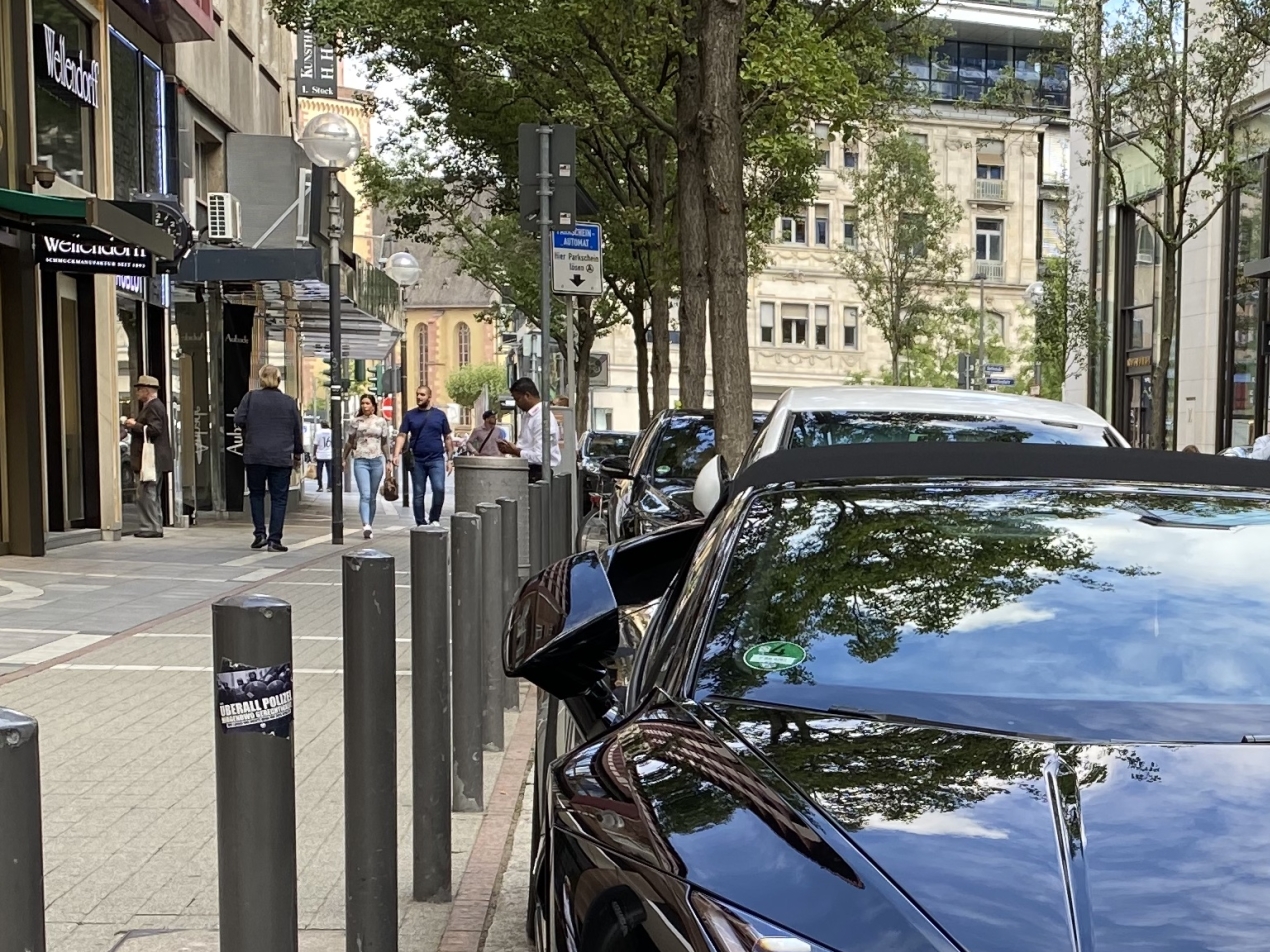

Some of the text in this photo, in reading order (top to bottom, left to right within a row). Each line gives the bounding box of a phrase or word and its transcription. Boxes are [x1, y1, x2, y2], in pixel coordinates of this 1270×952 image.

[43, 23, 100, 109] Wellendorff
[563, 237, 590, 248] AUTOMAT
[568, 253, 599, 263] Parkschein
[219, 699, 262, 717] ÜBERALL
